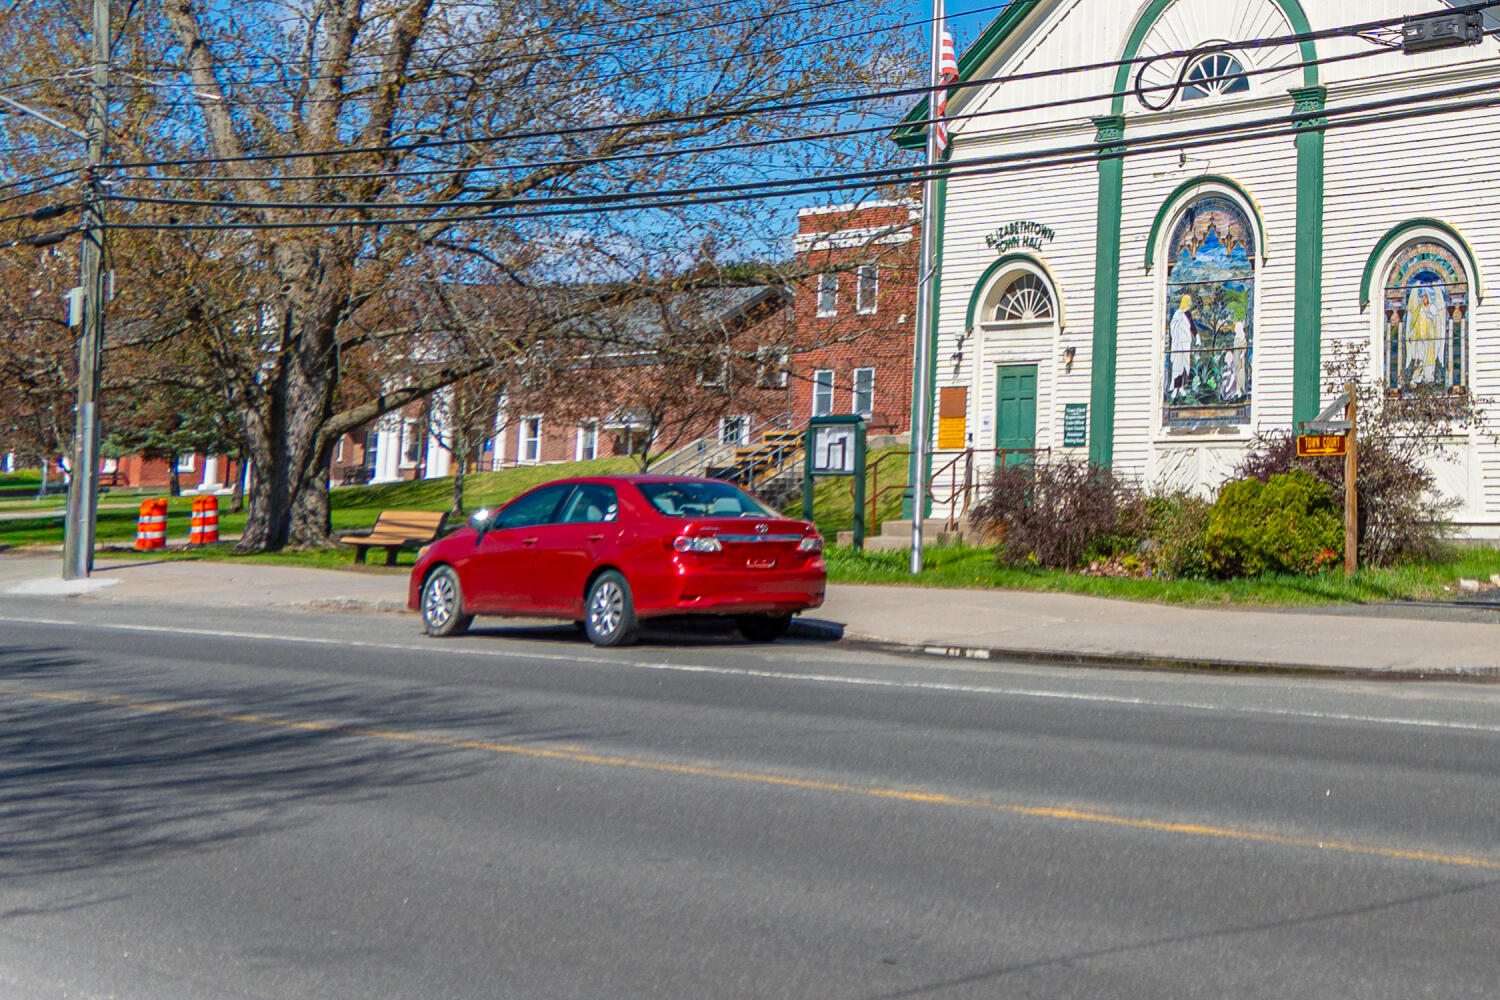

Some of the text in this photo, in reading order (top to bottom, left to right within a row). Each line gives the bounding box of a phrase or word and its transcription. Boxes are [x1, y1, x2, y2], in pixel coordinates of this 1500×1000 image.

[985, 220, 1056, 248] ELIZABETHTOWN
[996, 236, 1042, 254] TOWN HALL
[1305, 436, 1340, 448] TOWN COURT
